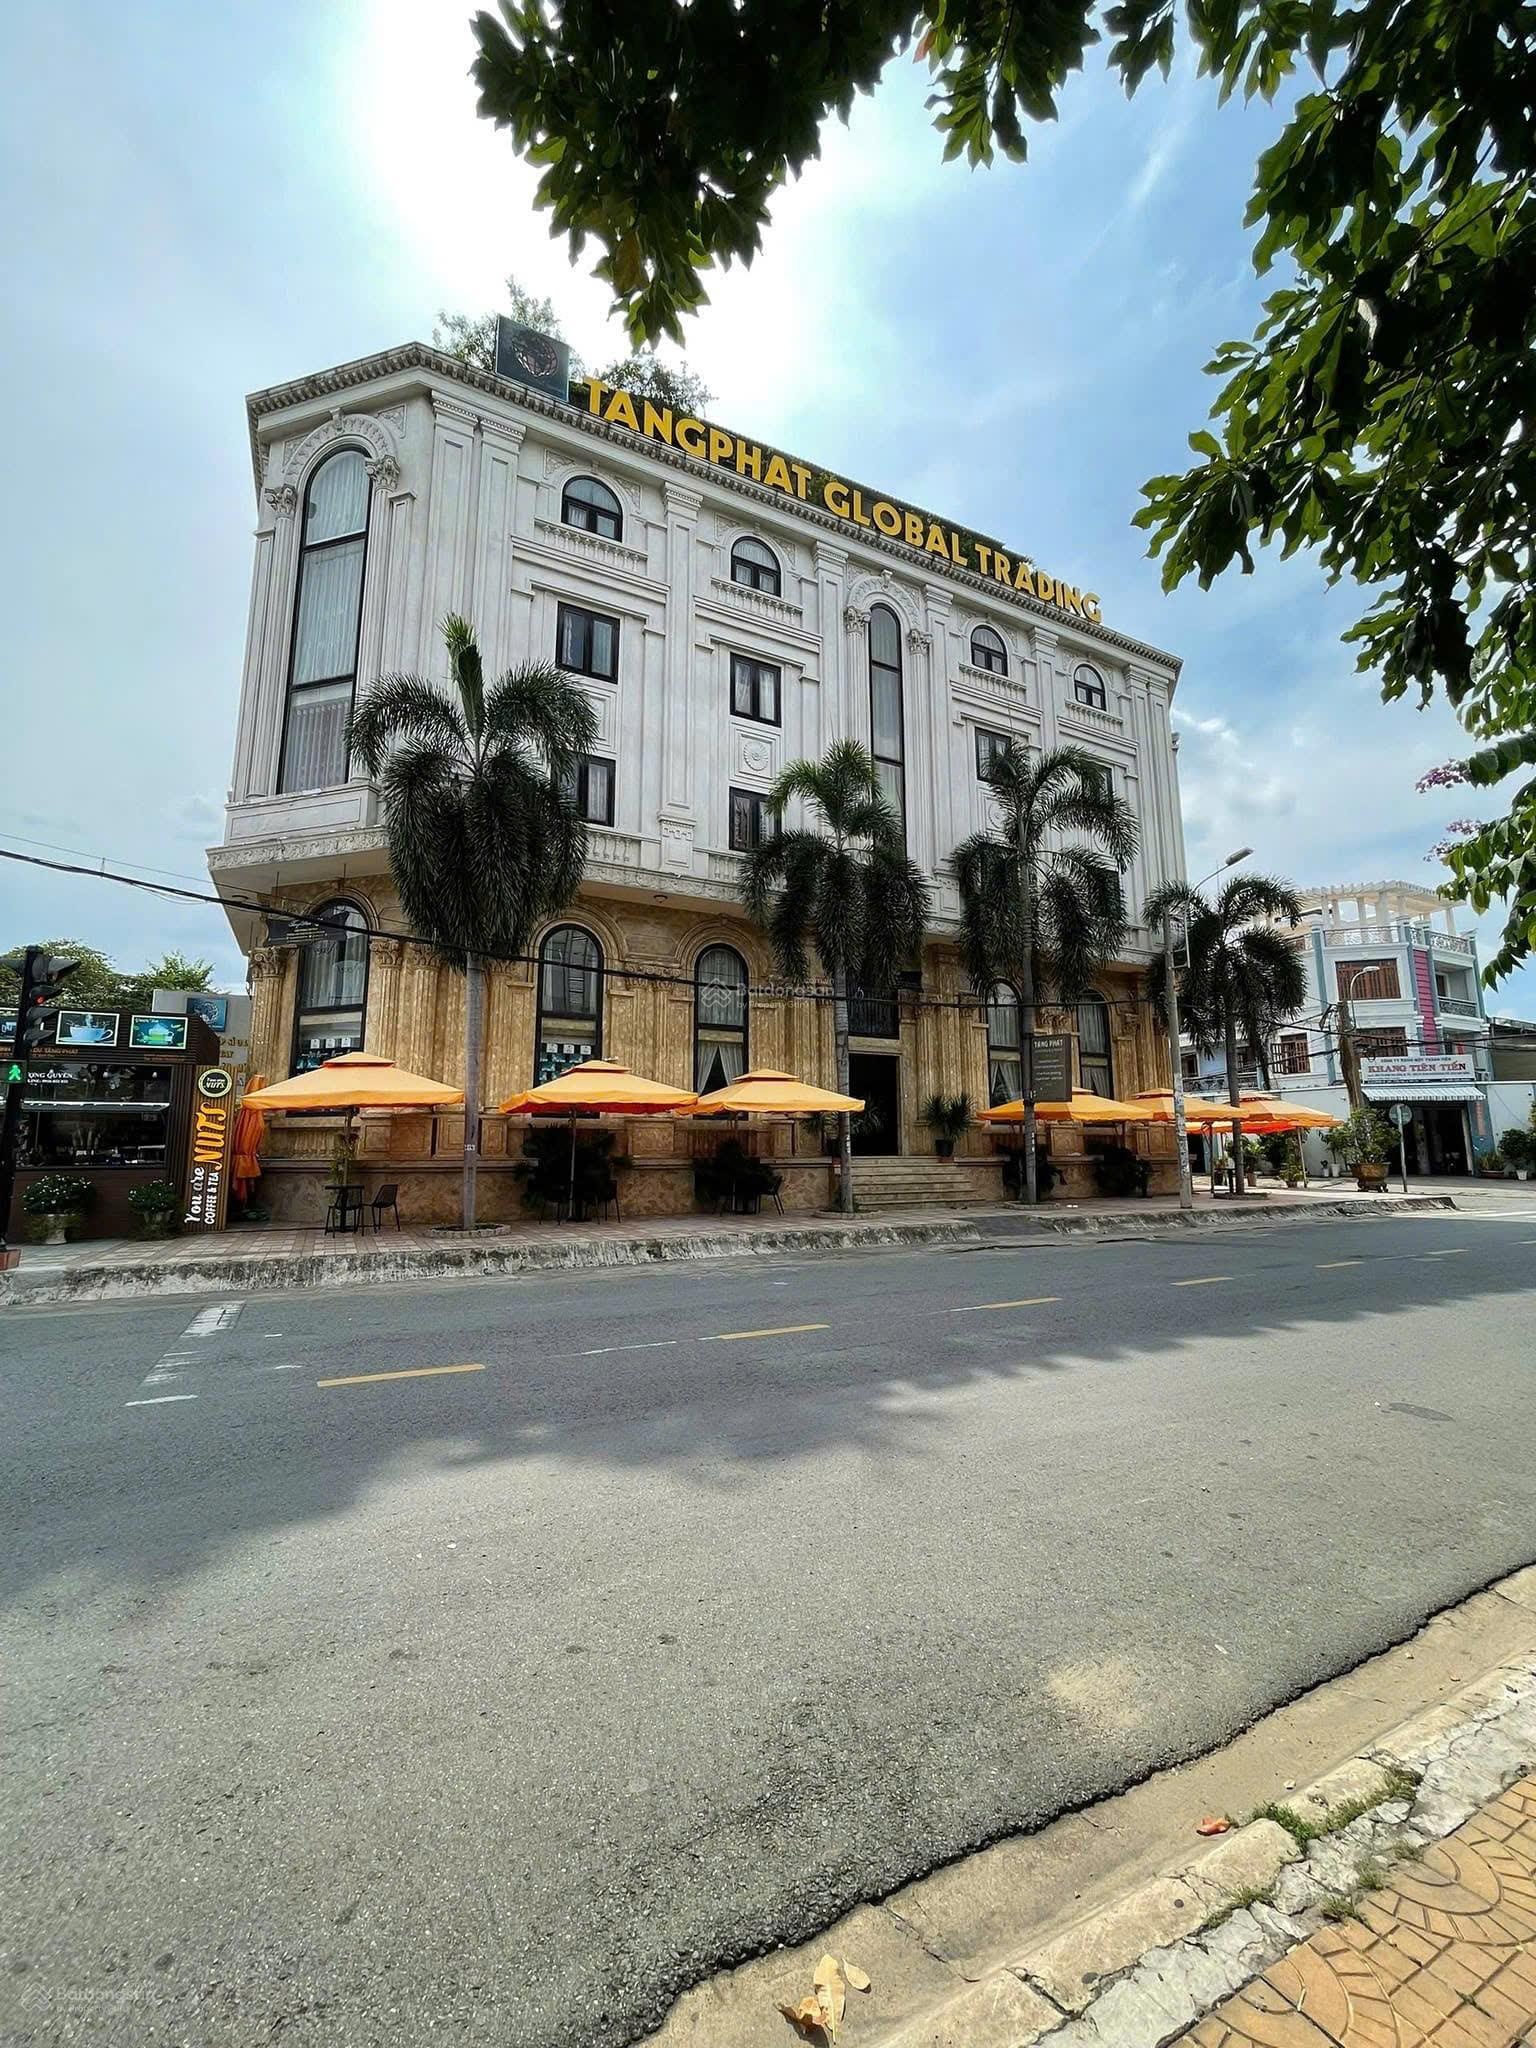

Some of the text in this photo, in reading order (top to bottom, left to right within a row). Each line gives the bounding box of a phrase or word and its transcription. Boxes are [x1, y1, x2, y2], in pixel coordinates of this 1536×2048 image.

[583, 376, 1103, 625] TANGPHAT GLOBAL TRADING
[1368, 1064, 1407, 1073] KHANG
[184, 1101, 227, 1224] You are NUTS
[208, 1172, 220, 1187] TEA
[204, 1195, 217, 1225] COFFEE
